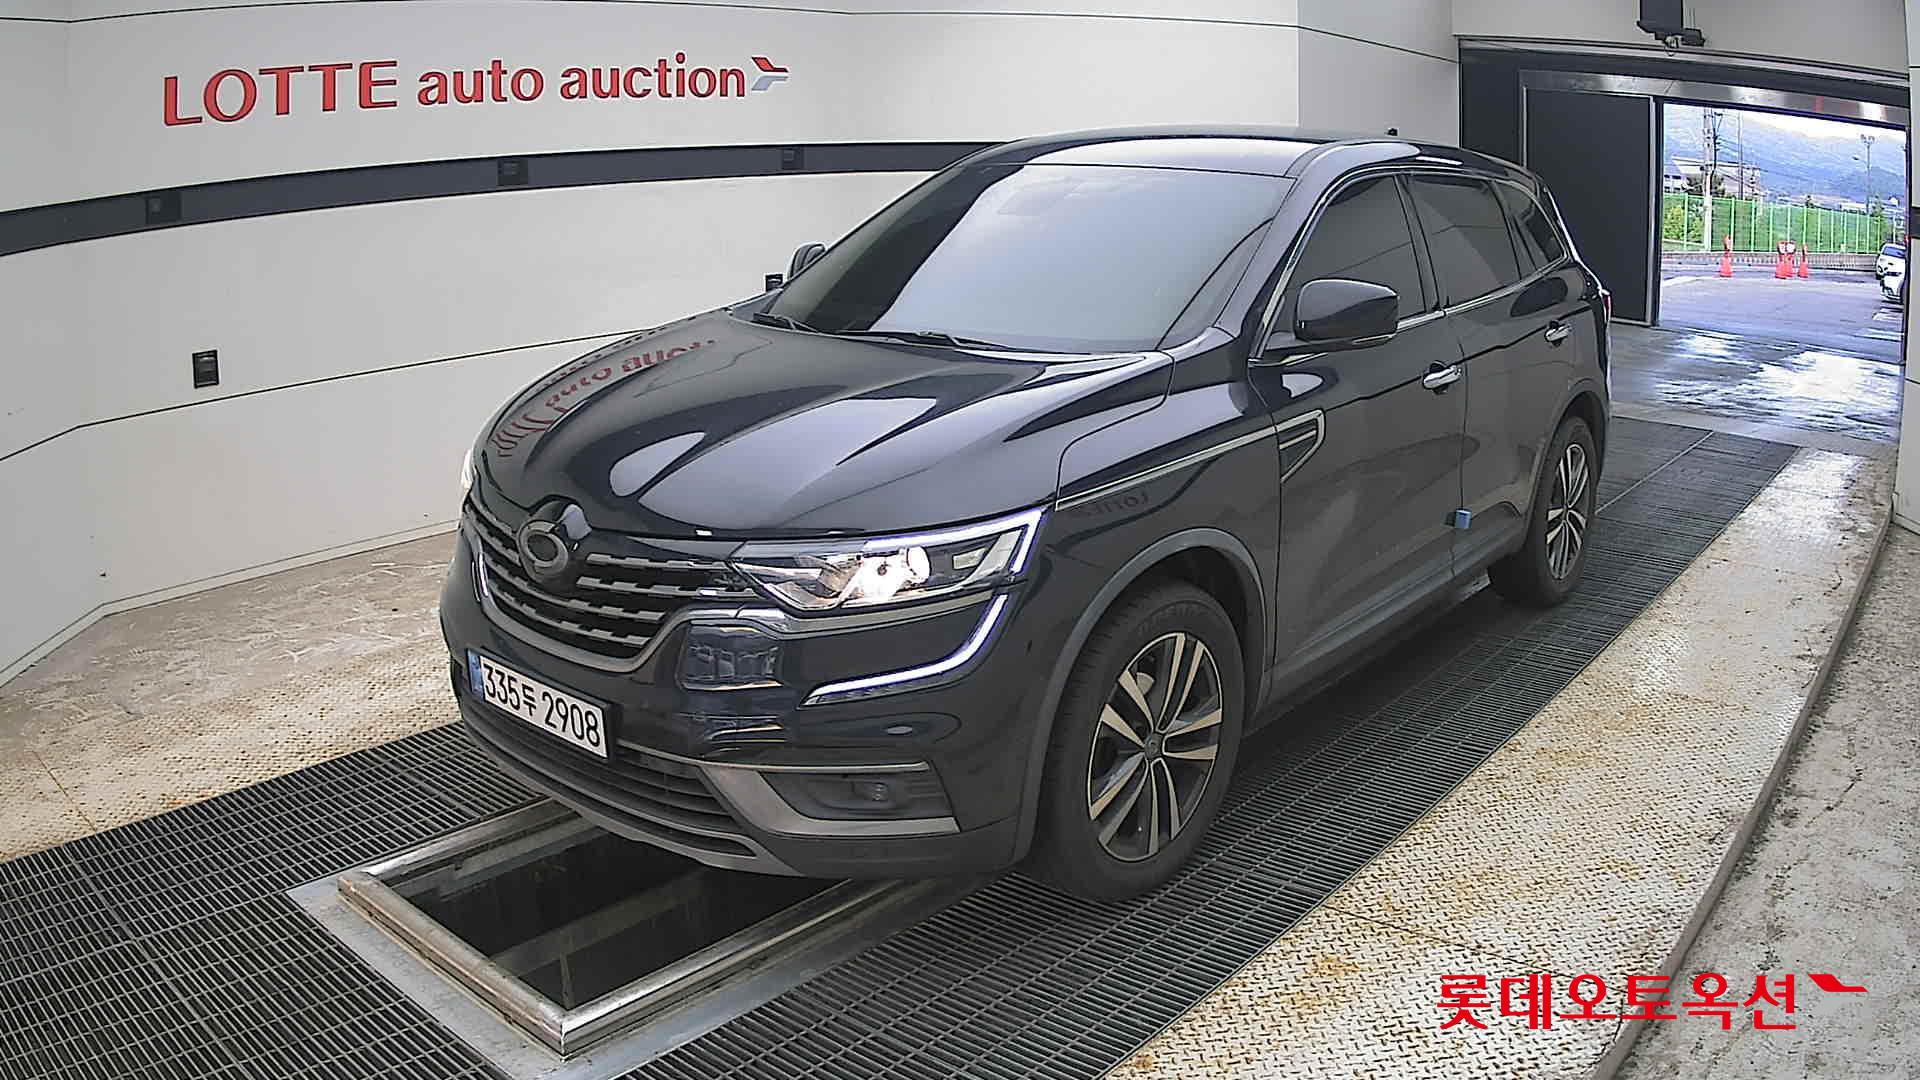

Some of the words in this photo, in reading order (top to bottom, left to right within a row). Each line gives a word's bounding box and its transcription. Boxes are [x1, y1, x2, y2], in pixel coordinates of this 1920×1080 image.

[163, 60, 398, 126] LOTTE
[417, 58, 544, 105] auto
[560, 52, 746, 99] auction
[483, 662, 537, 717] 335두
[542, 691, 600, 748] 2908
